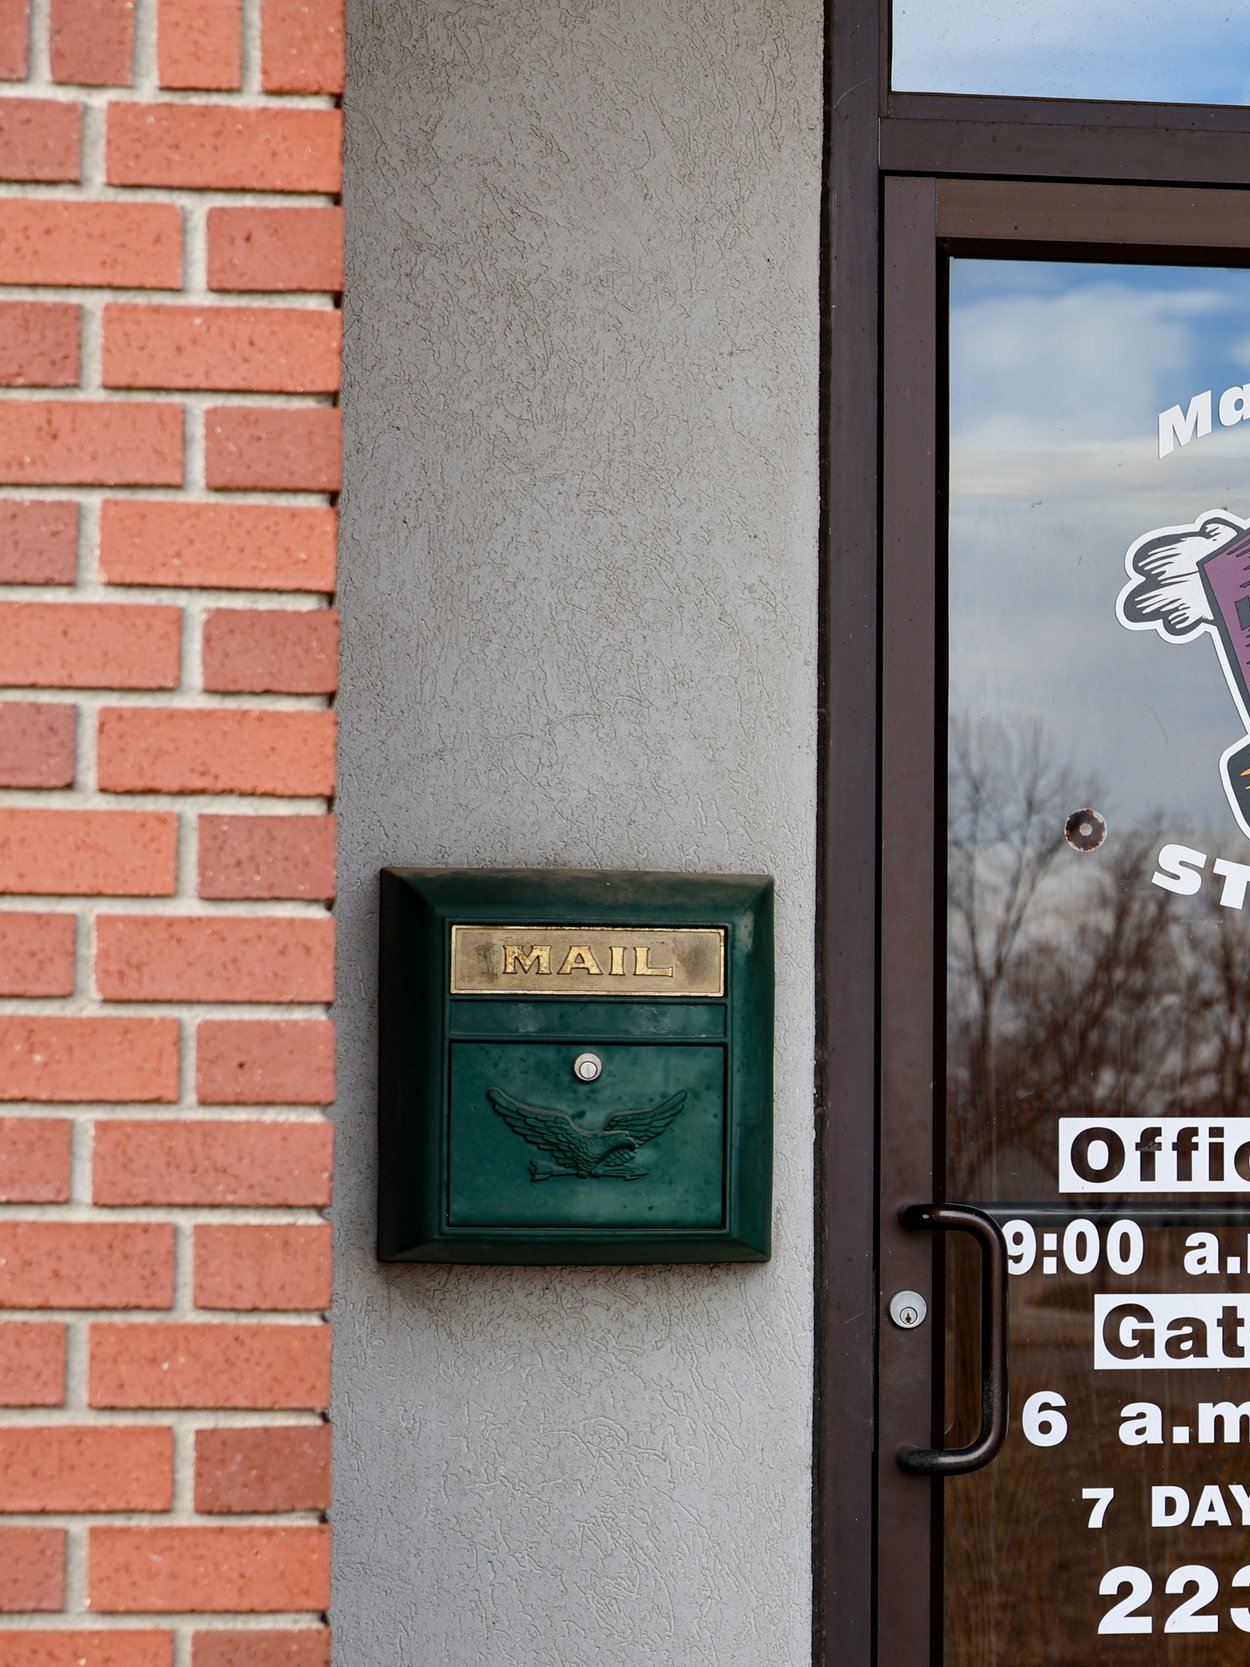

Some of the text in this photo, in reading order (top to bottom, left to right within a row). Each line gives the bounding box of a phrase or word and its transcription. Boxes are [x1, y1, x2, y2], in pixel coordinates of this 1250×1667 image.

[503, 945, 673, 977] MAIL
[1003, 1219, 1144, 1276] 9:00
[1021, 1390, 1068, 1447] 6
[1082, 1487, 1115, 1528] 7
